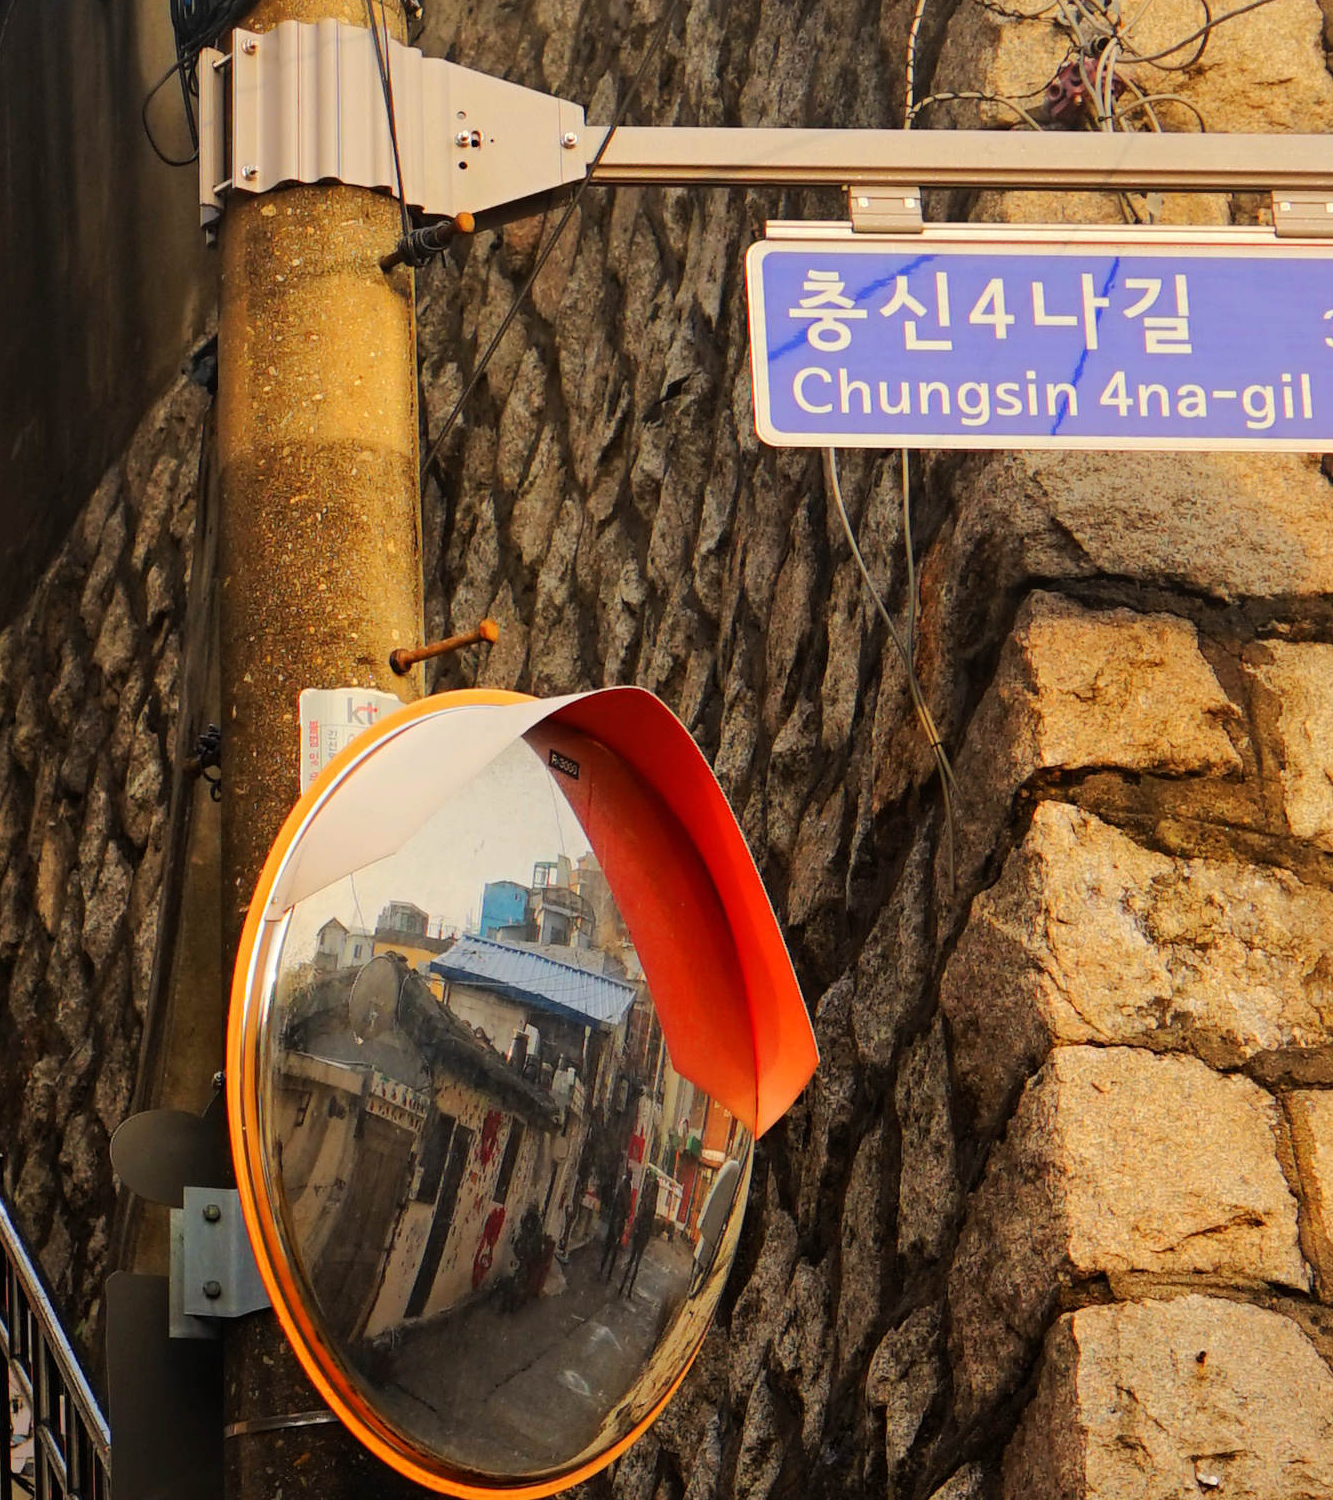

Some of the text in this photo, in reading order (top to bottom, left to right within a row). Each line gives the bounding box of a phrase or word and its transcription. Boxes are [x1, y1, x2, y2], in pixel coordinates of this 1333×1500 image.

[789, 269, 1192, 354] 충신4나길
[792, 367, 1313, 430] Chungsin 4na-gil
[347, 697, 378, 725] kt
